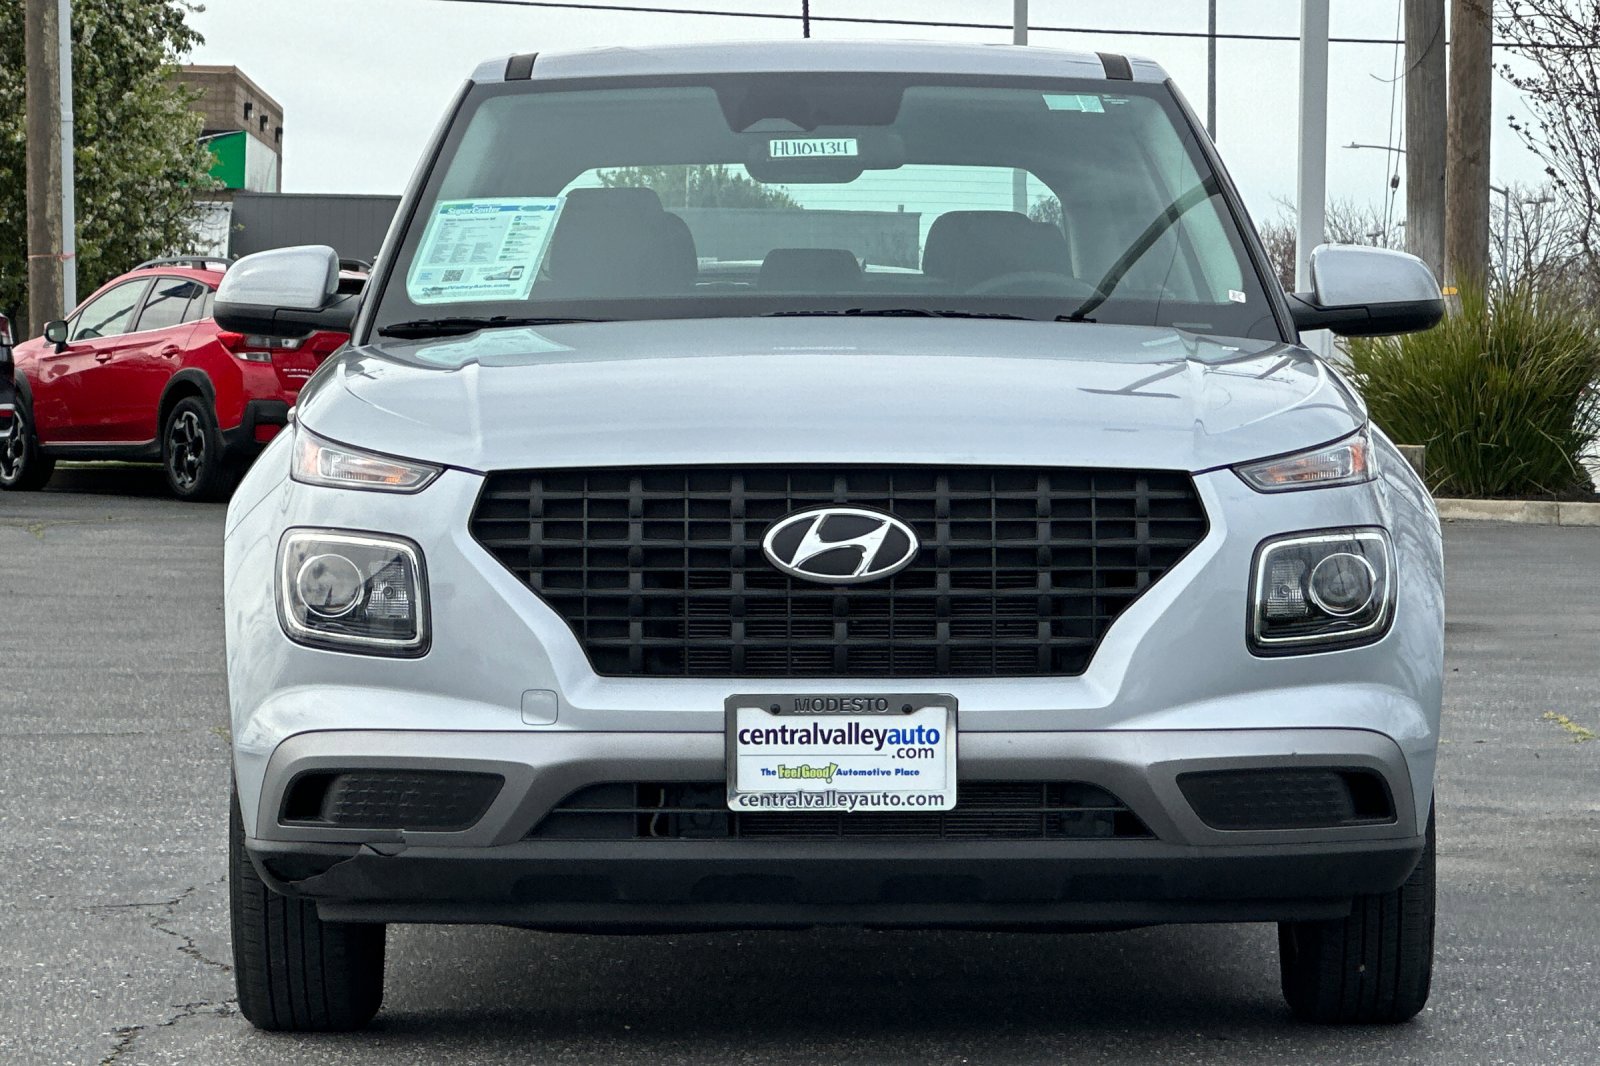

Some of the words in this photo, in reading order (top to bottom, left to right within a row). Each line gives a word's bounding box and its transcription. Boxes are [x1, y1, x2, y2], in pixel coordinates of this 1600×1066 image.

[794, 697, 889, 713] MODESTO
[738, 722, 940, 751] centralvalleyauto
[891, 747, 935, 759] .com
[761, 768, 776, 777] The
[836, 767, 891, 777] Automotive
[895, 767, 920, 777] Place
[738, 790, 945, 811] centralvalleyauto.com
